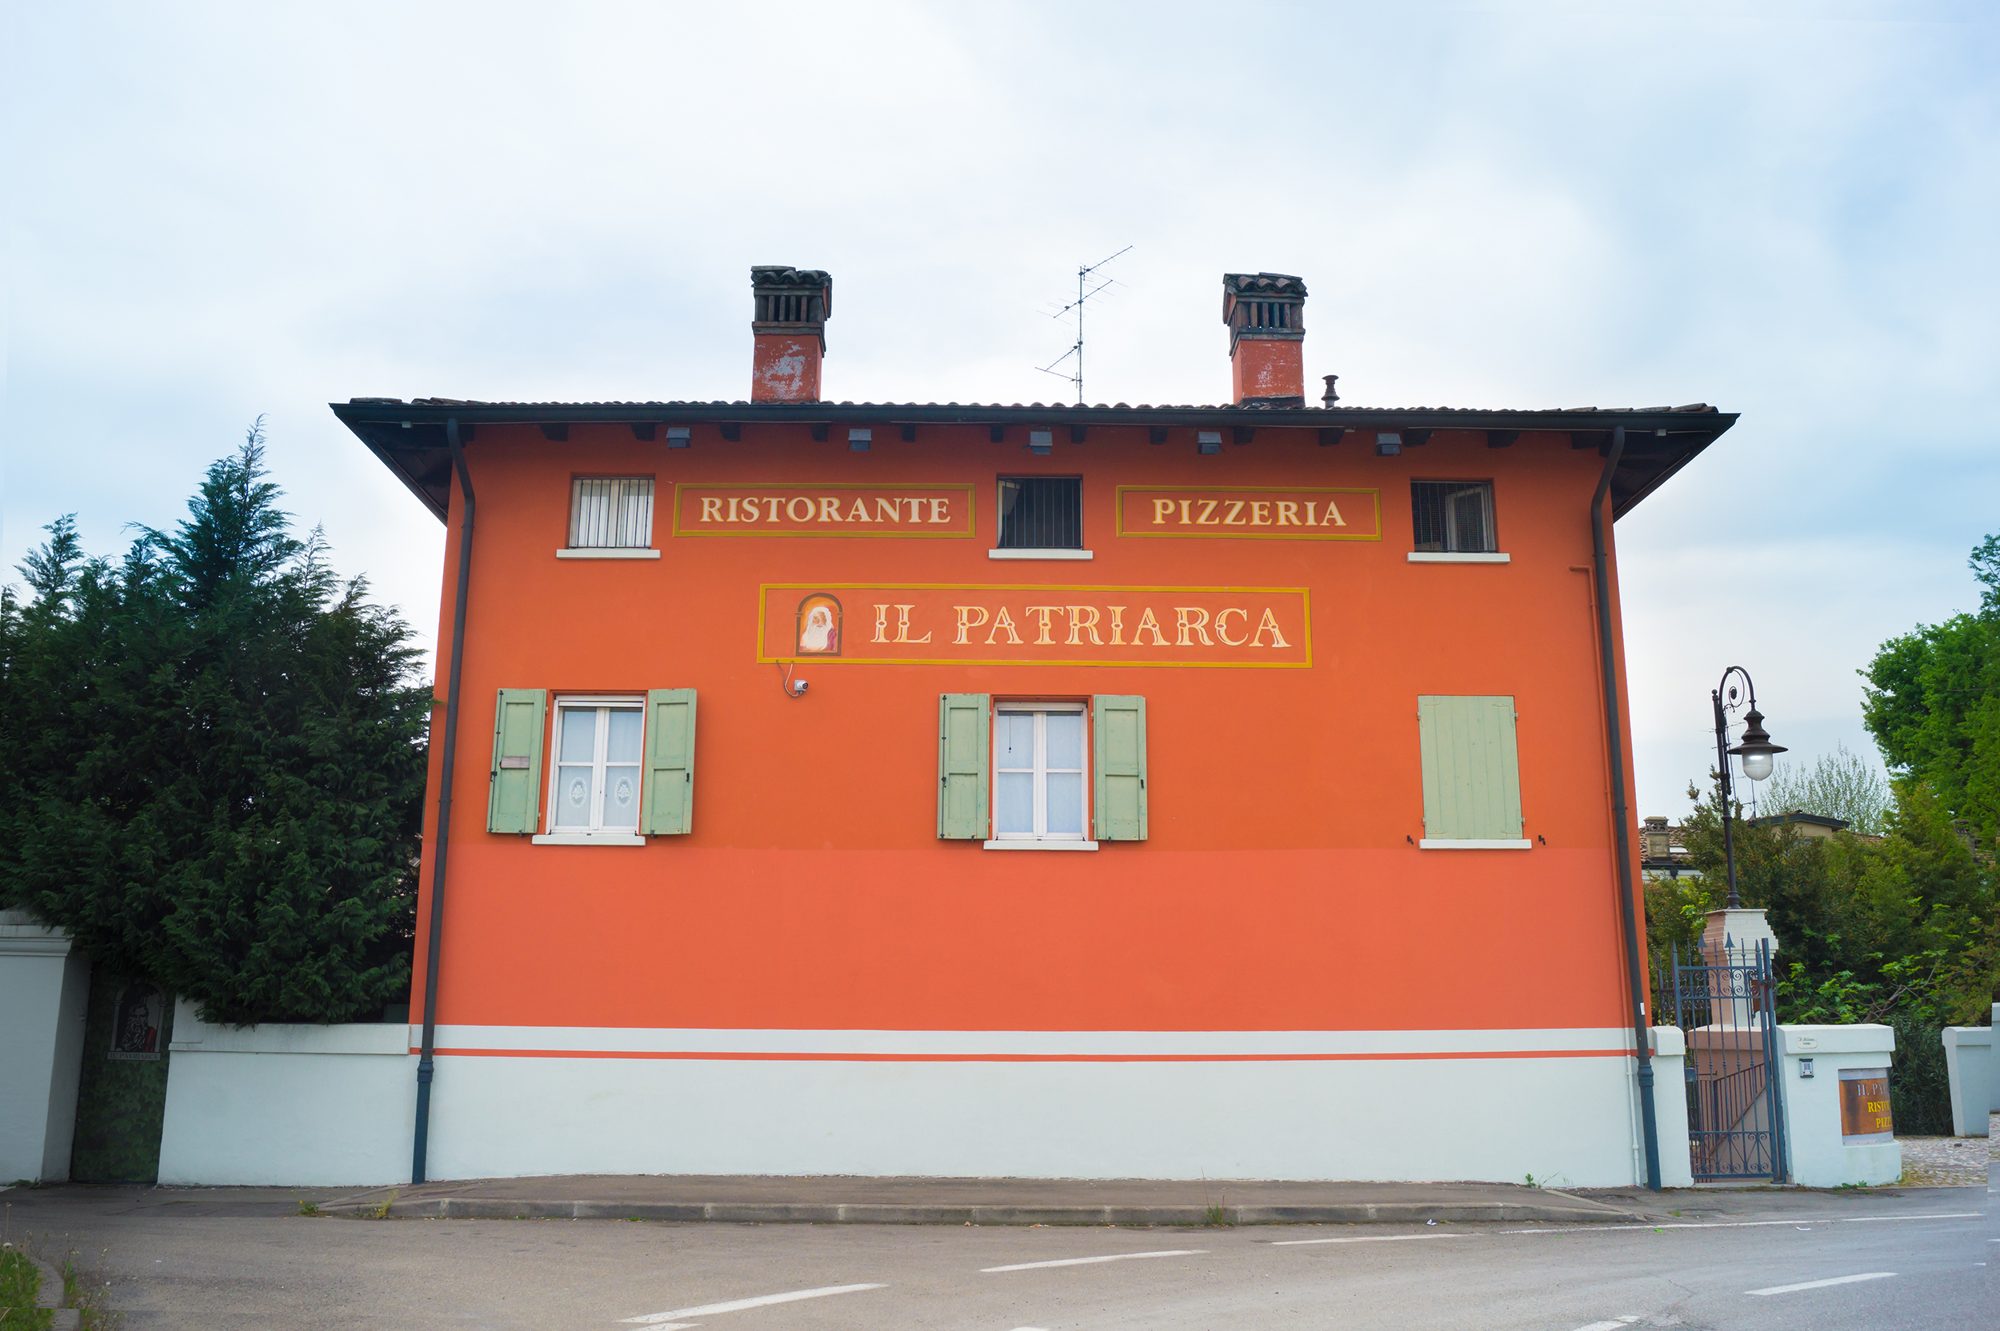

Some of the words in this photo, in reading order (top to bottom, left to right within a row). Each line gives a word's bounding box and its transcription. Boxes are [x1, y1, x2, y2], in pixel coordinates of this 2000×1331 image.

[698, 496, 952, 524] RISTORANTE
[1152, 498, 1348, 527] PIZZERIA
[869, 603, 933, 645] IL
[951, 605, 1293, 649] PATRIARCA
